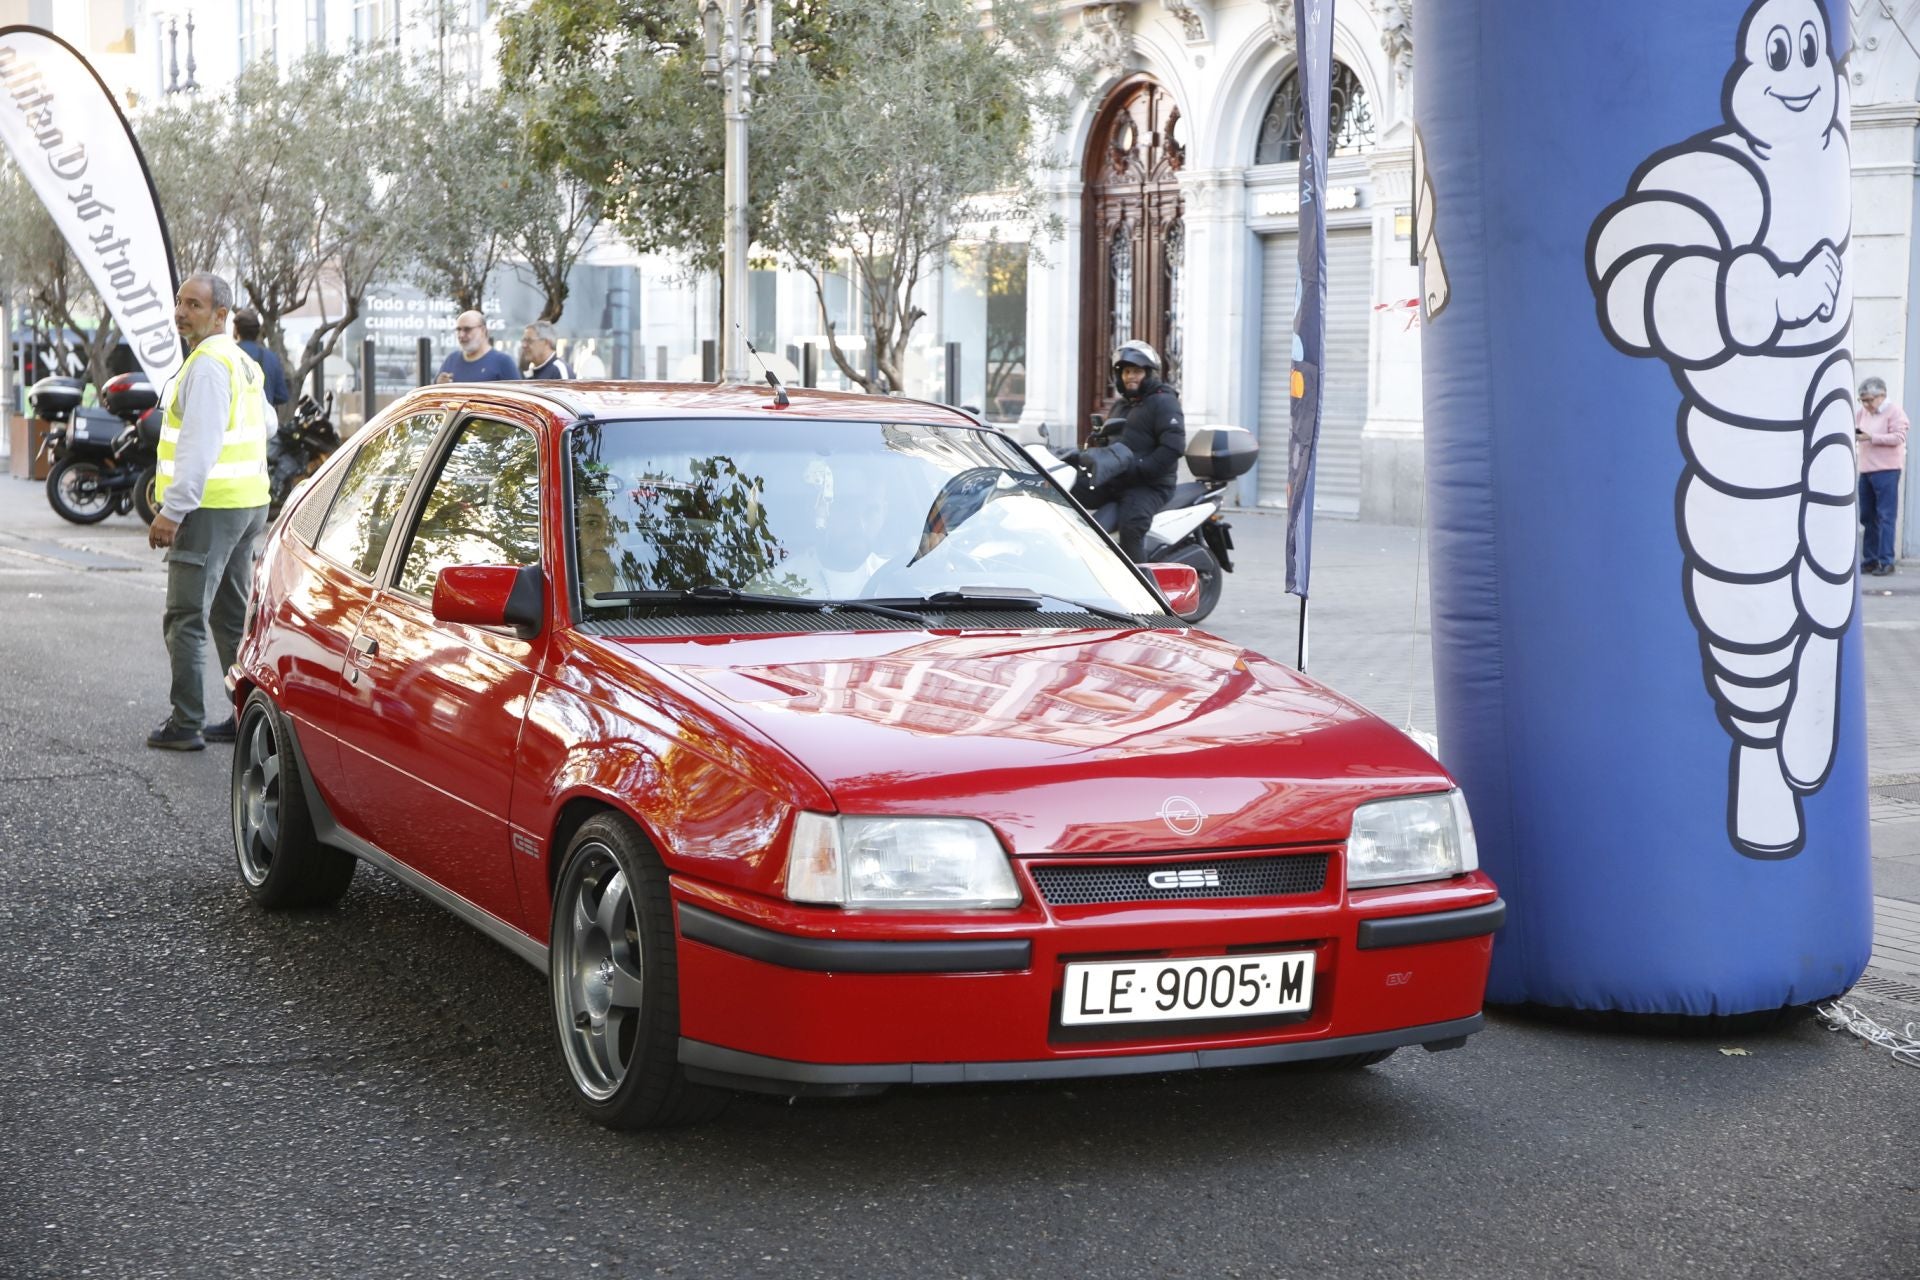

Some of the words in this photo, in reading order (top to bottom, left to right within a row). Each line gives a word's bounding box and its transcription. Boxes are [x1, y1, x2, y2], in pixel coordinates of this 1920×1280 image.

[366, 295, 403, 311] Todo
[407, 299, 426, 312] es
[364, 314, 424, 329] cuando
[428, 314, 506, 330] habos
